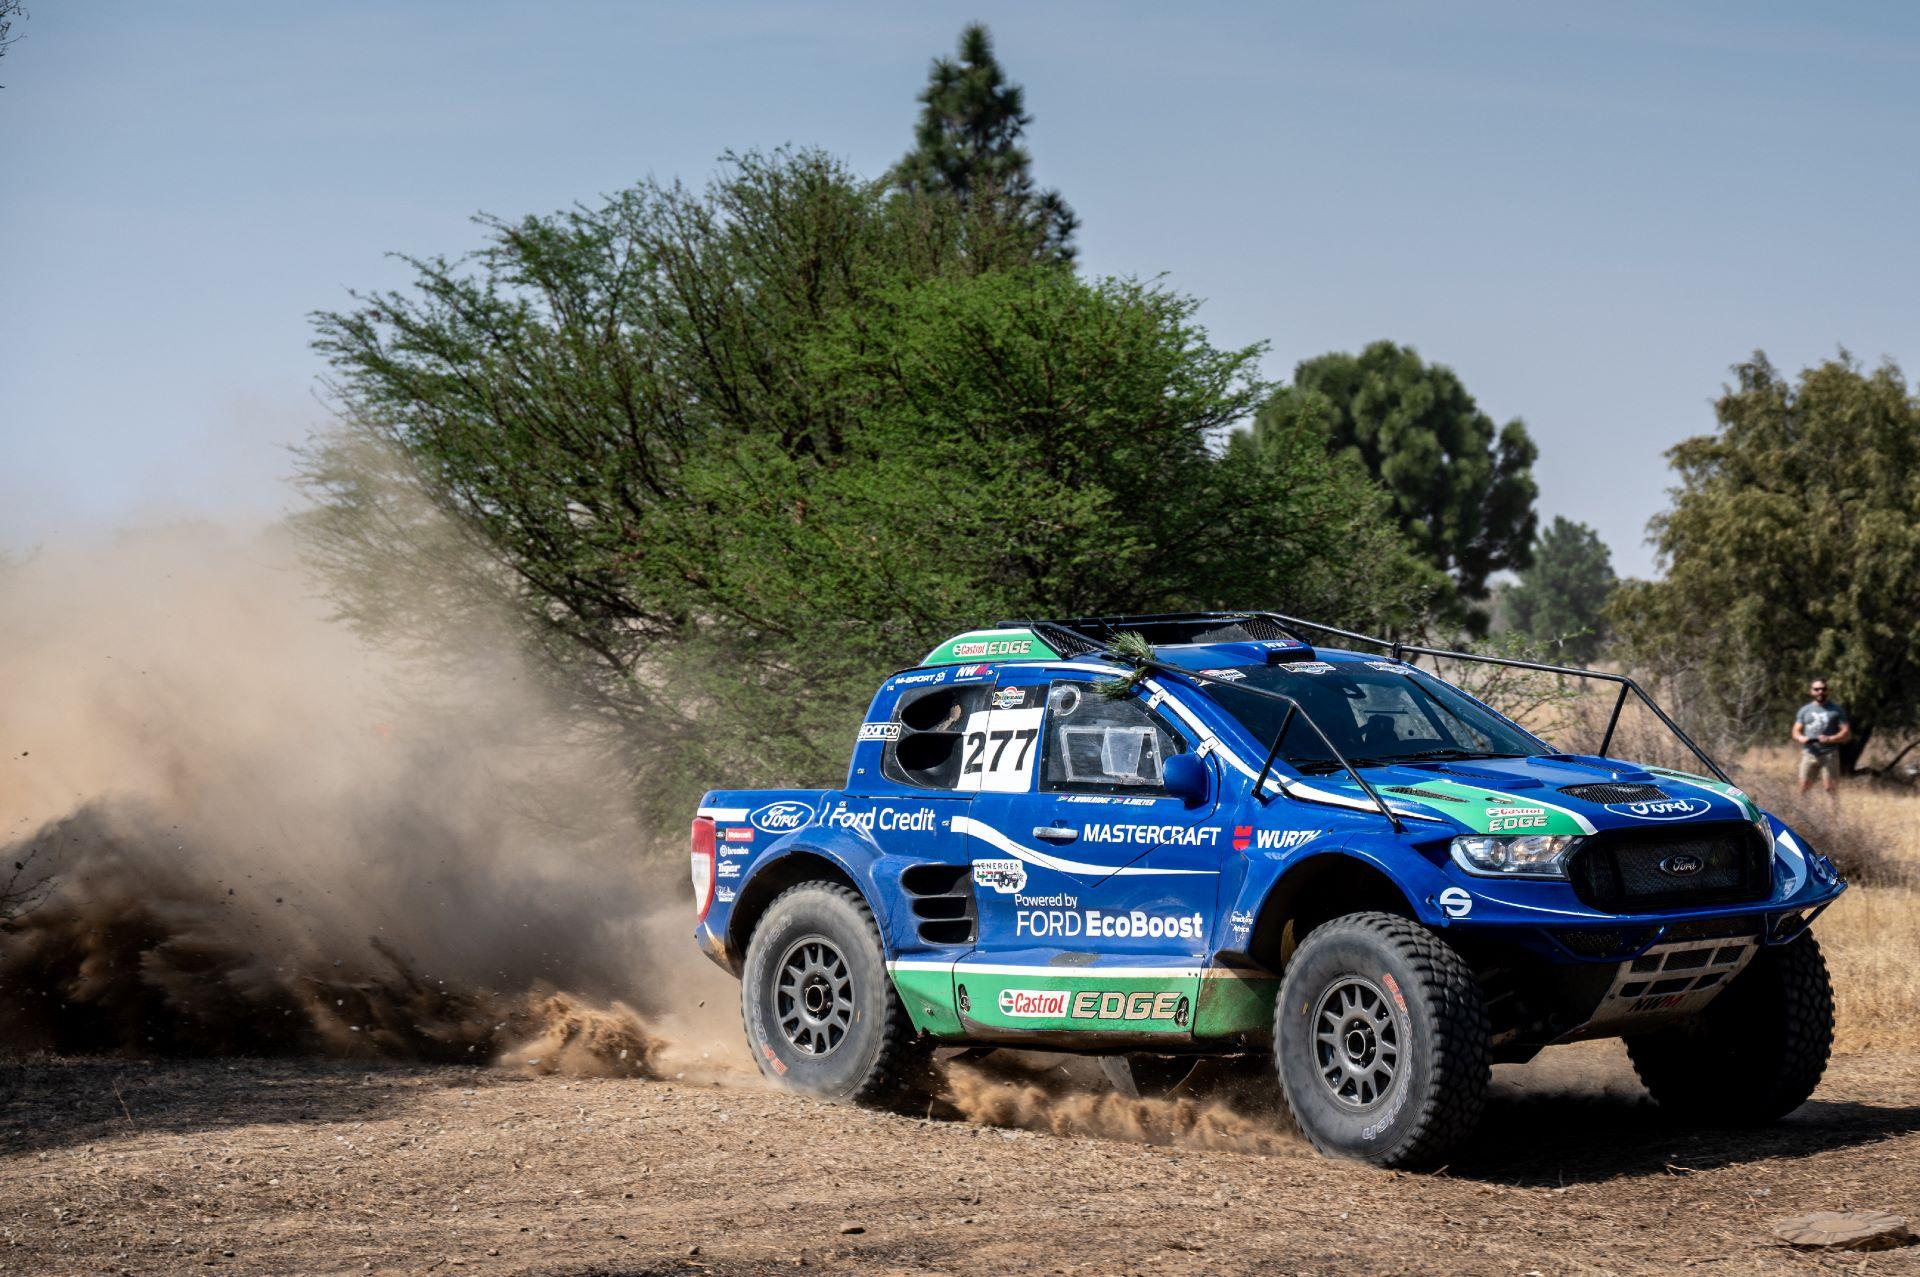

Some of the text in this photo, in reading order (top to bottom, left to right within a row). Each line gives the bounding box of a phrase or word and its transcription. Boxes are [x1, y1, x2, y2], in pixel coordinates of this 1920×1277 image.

[961, 640, 1033, 655] Castrol EDGE
[895, 674, 937, 685] M-SPORT
[964, 728, 1038, 774] 277
[761, 805, 804, 828] Ford
[1628, 799, 1694, 815] Ford
[828, 806, 936, 831] Ford Credit
[1488, 815, 1550, 833] EDGE
[1083, 823, 1222, 846] MASTERCRAFT
[728, 846, 749, 855] brembo
[1015, 893, 1078, 909] Powered by
[1016, 910, 1203, 938] FORD EcoBoost
[1015, 991, 1183, 1020] Castrol EDGE
